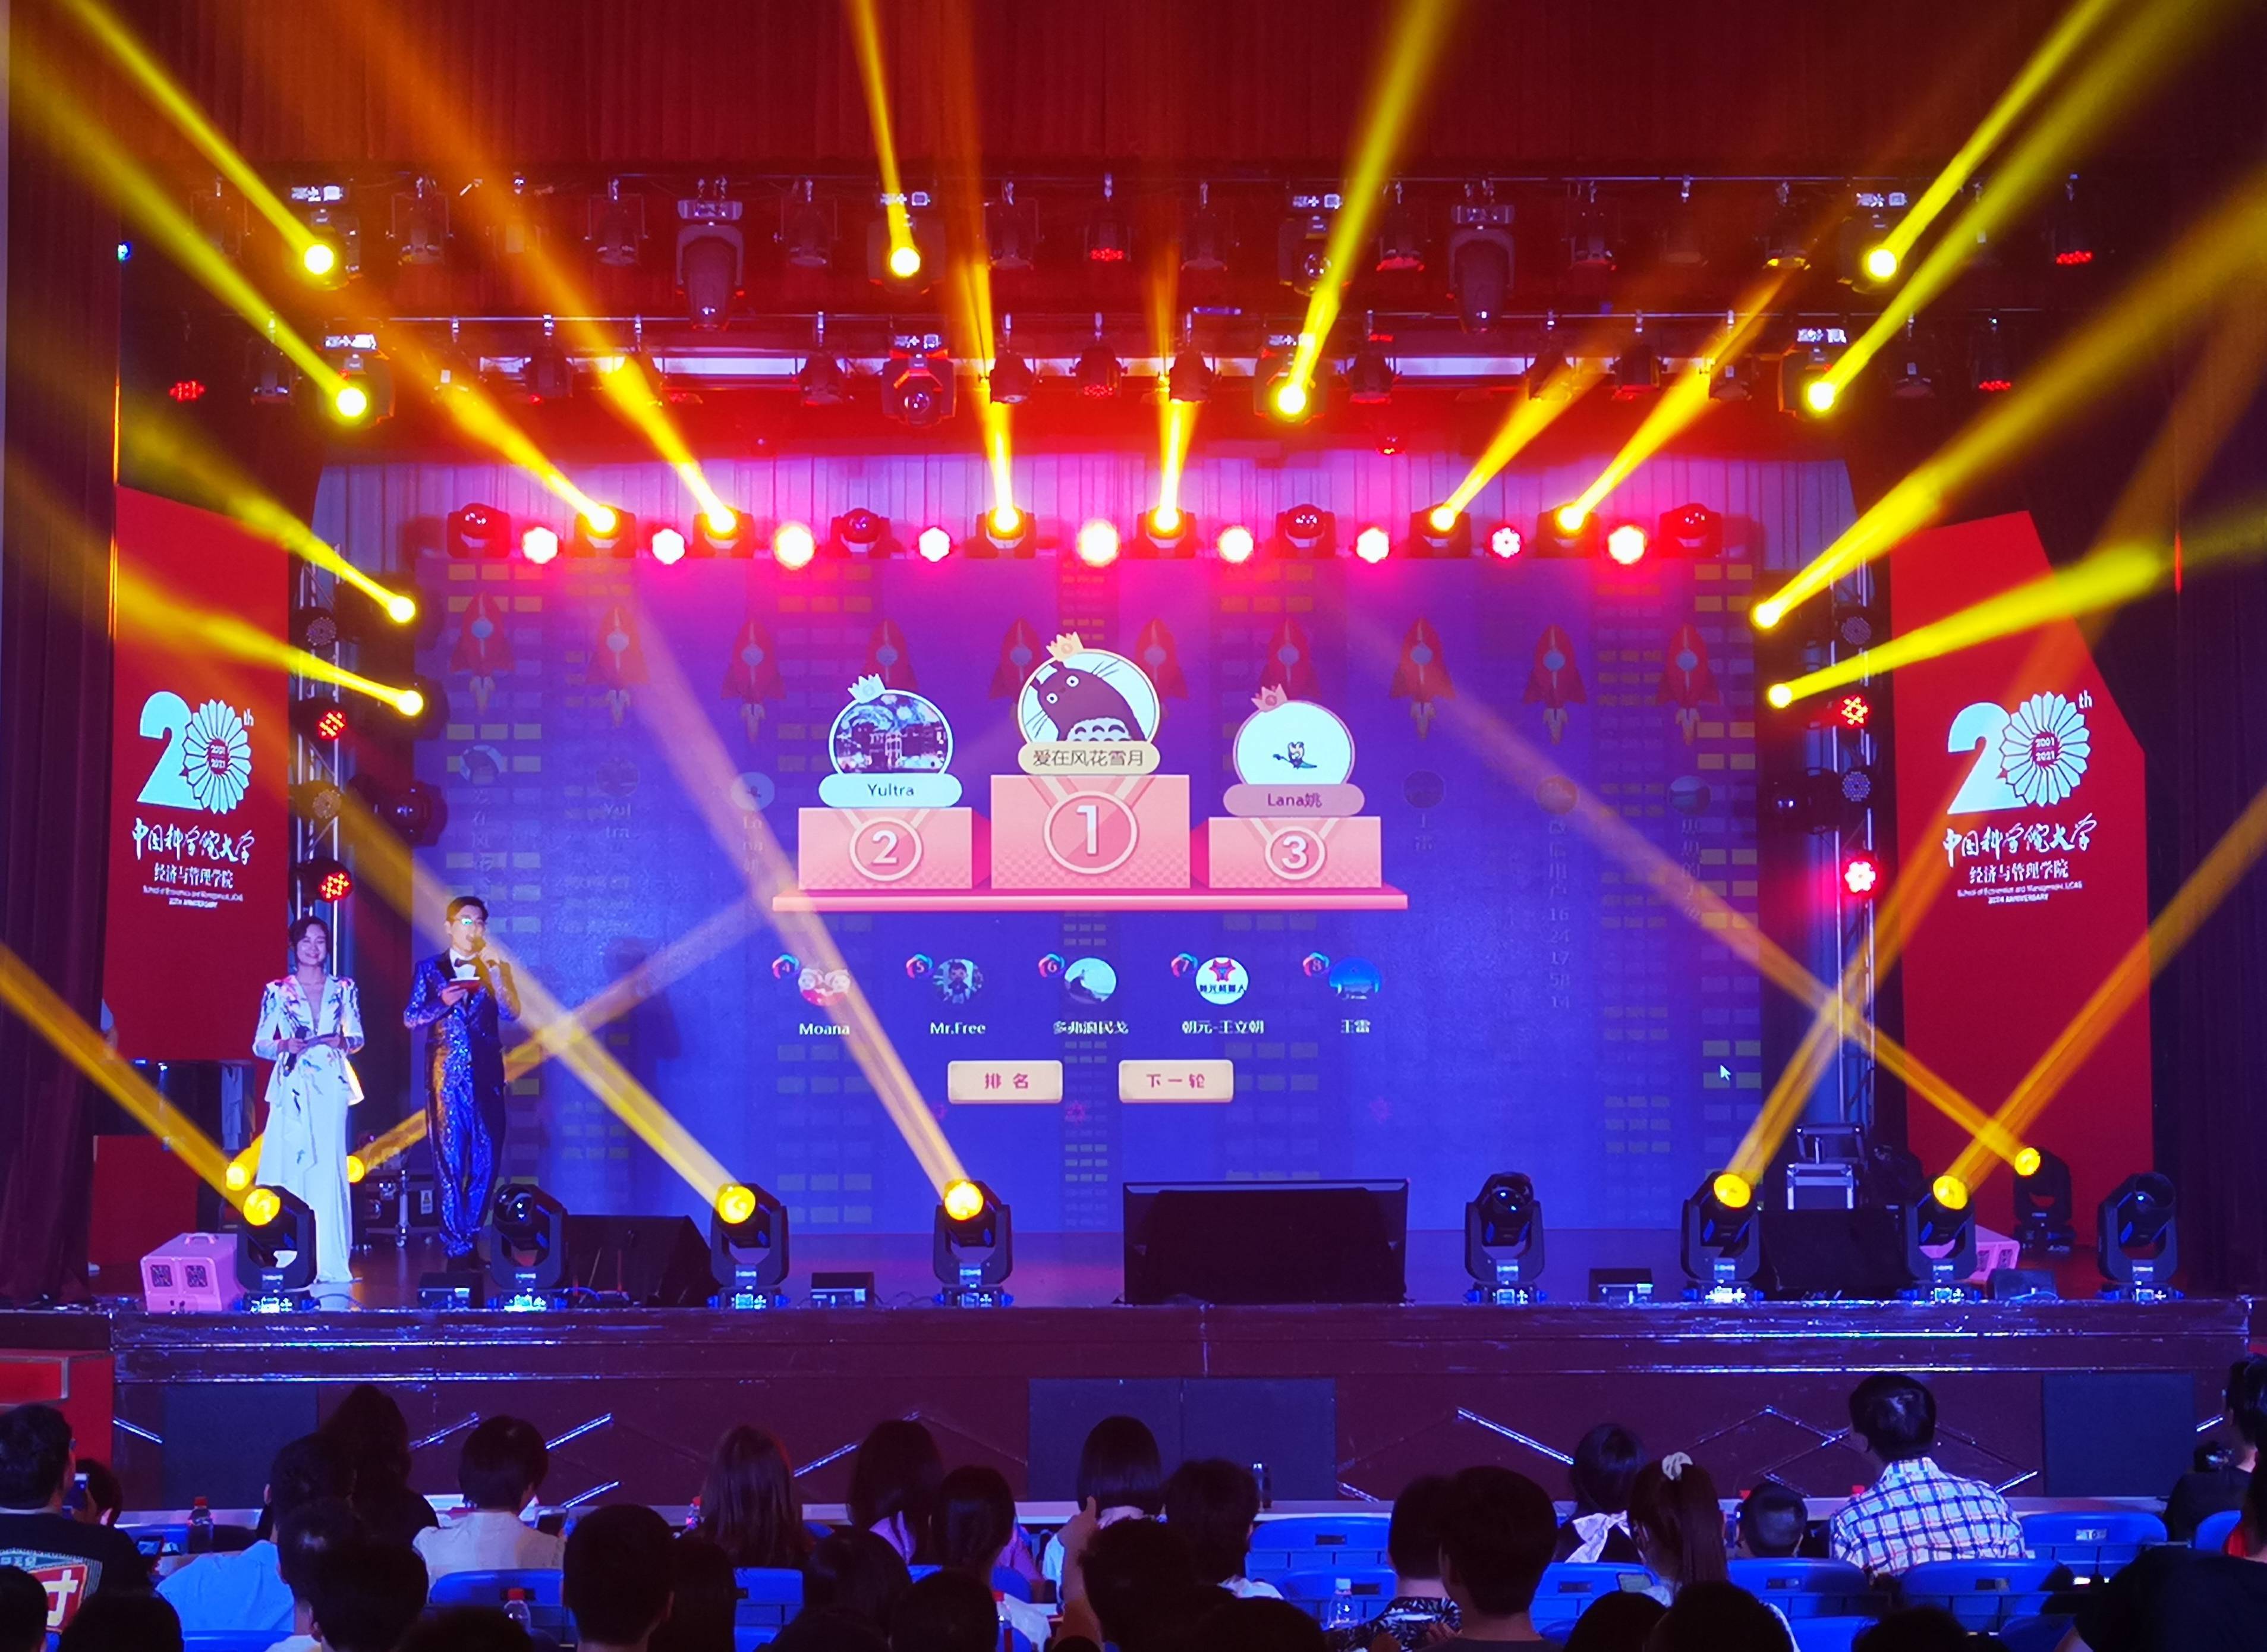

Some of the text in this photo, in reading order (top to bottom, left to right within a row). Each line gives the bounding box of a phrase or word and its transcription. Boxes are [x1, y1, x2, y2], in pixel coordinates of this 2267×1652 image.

[2035, 737, 2054, 747] 2001
[1033, 749, 1142, 766] 爱在风花雪月
[2036, 750, 2054, 762] 2021
[867, 783, 914, 797] Yultra
[1076, 806, 1100, 855] 1
[132, 817, 254, 865] 中国科学院大学
[871, 829, 898, 865] 2
[1942, 813, 2096, 867] 中国科学院大学
[1282, 833, 1307, 869] 3
[1969, 858, 2069, 885] 经济与管理学院
[1048, 961, 1057, 973] 6
[1312, 959, 1322, 971] 8
[799, 1022, 850, 1036] Moana
[930, 1021, 986, 1036] Mr.Free
[984, 1073, 1029, 1090] 排名
[1147, 1073, 1206, 1089] 下一轮
